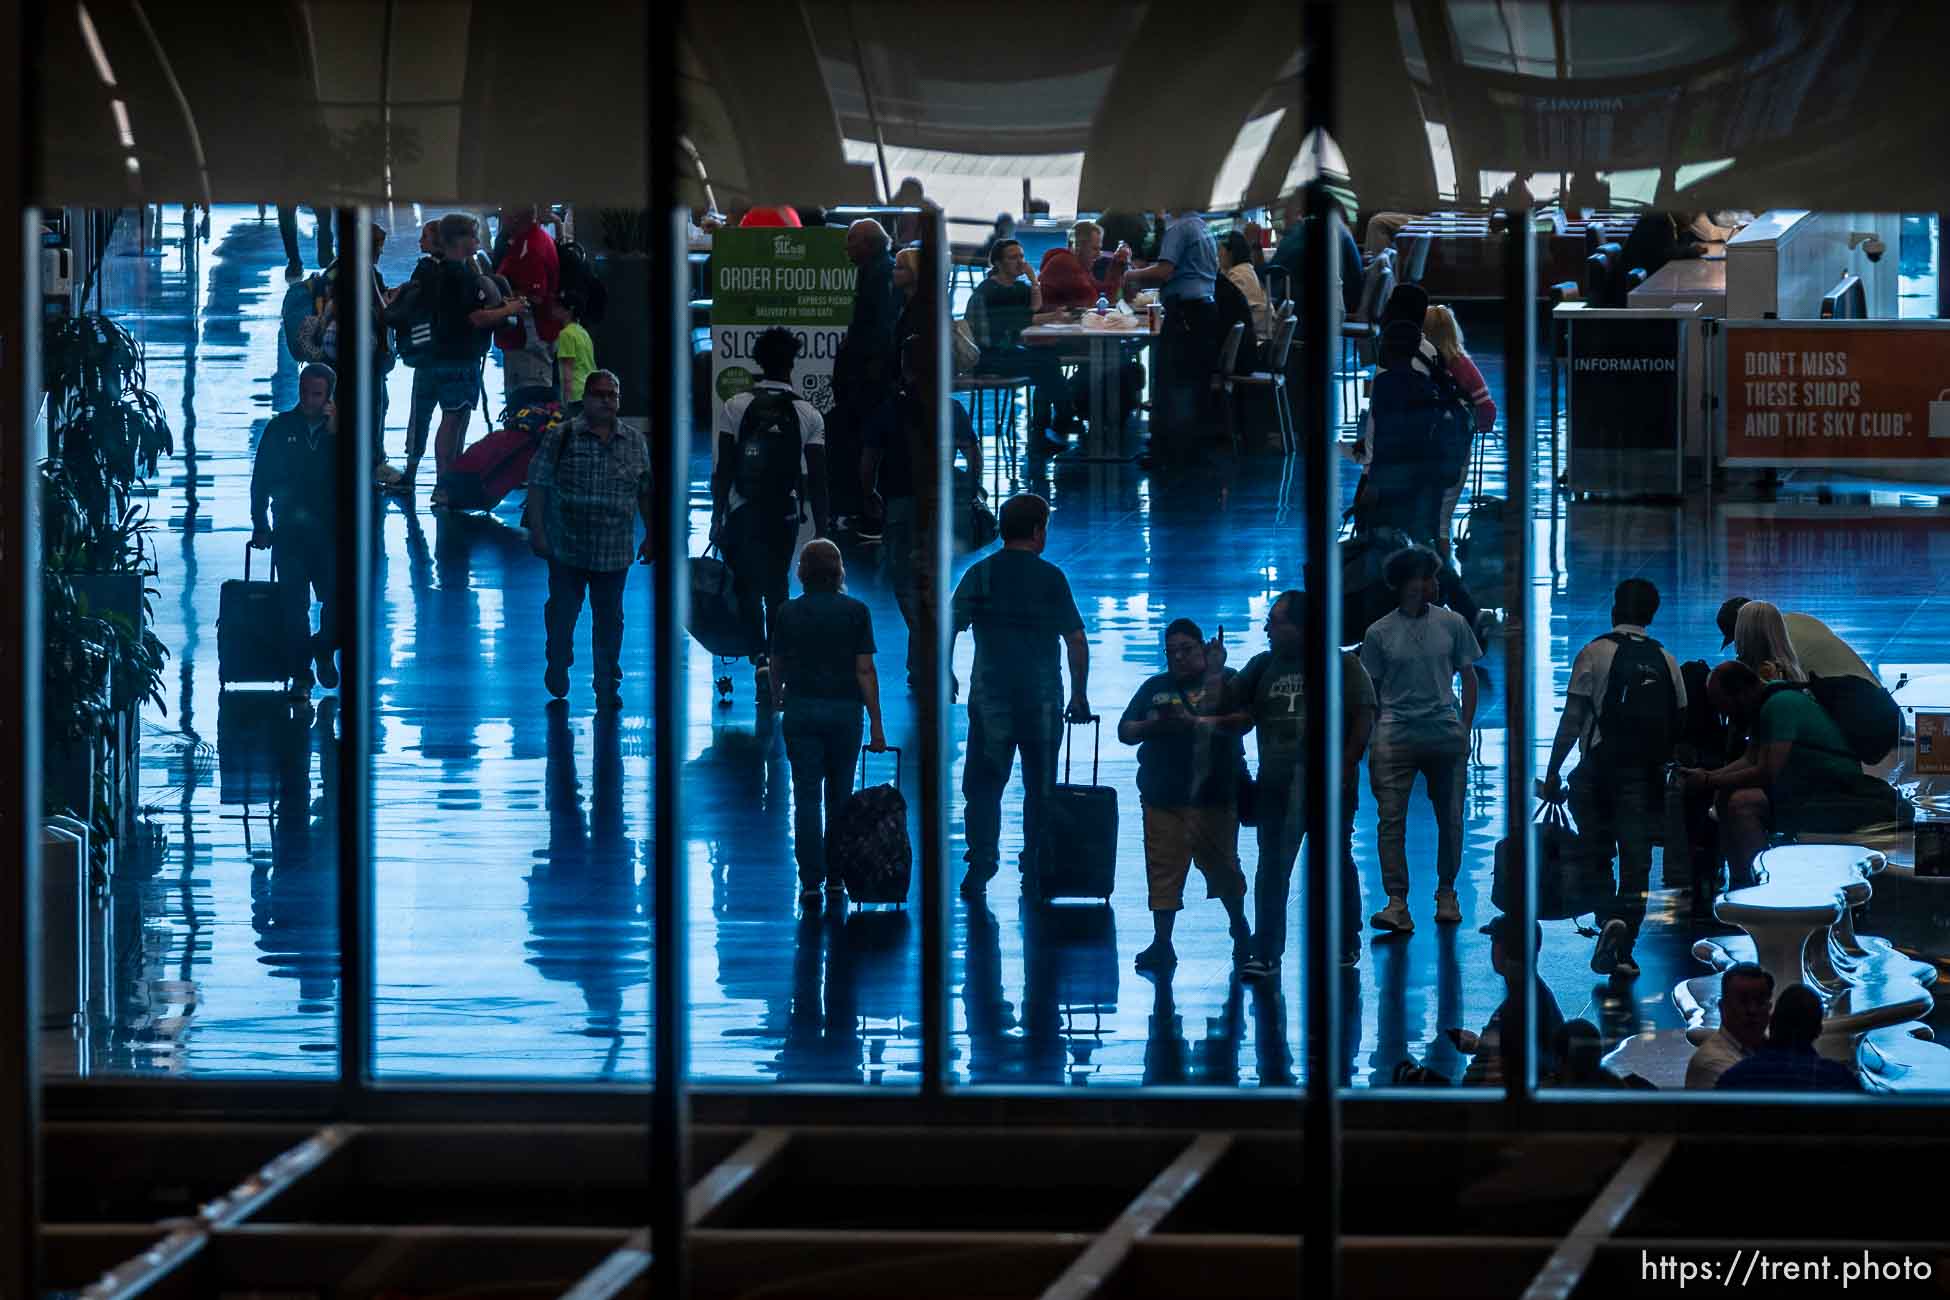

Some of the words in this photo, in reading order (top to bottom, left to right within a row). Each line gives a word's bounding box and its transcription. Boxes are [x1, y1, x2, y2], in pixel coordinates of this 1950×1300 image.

[720, 266, 771, 290] ORDER
[775, 266, 816, 291] FOOD
[819, 266, 858, 291] NOW
[798, 295, 827, 305] EXPRESS
[1574, 358, 1675, 372] INFORMATION
[1744, 351, 1796, 376] DON'T
[1801, 351, 1848, 376] MISS
[1744, 381, 1799, 406] THESE
[1803, 381, 1861, 407] SHOPS
[1744, 411, 1780, 437] AND
[1784, 411, 1817, 437] THE
[1823, 411, 1855, 437] SKY
